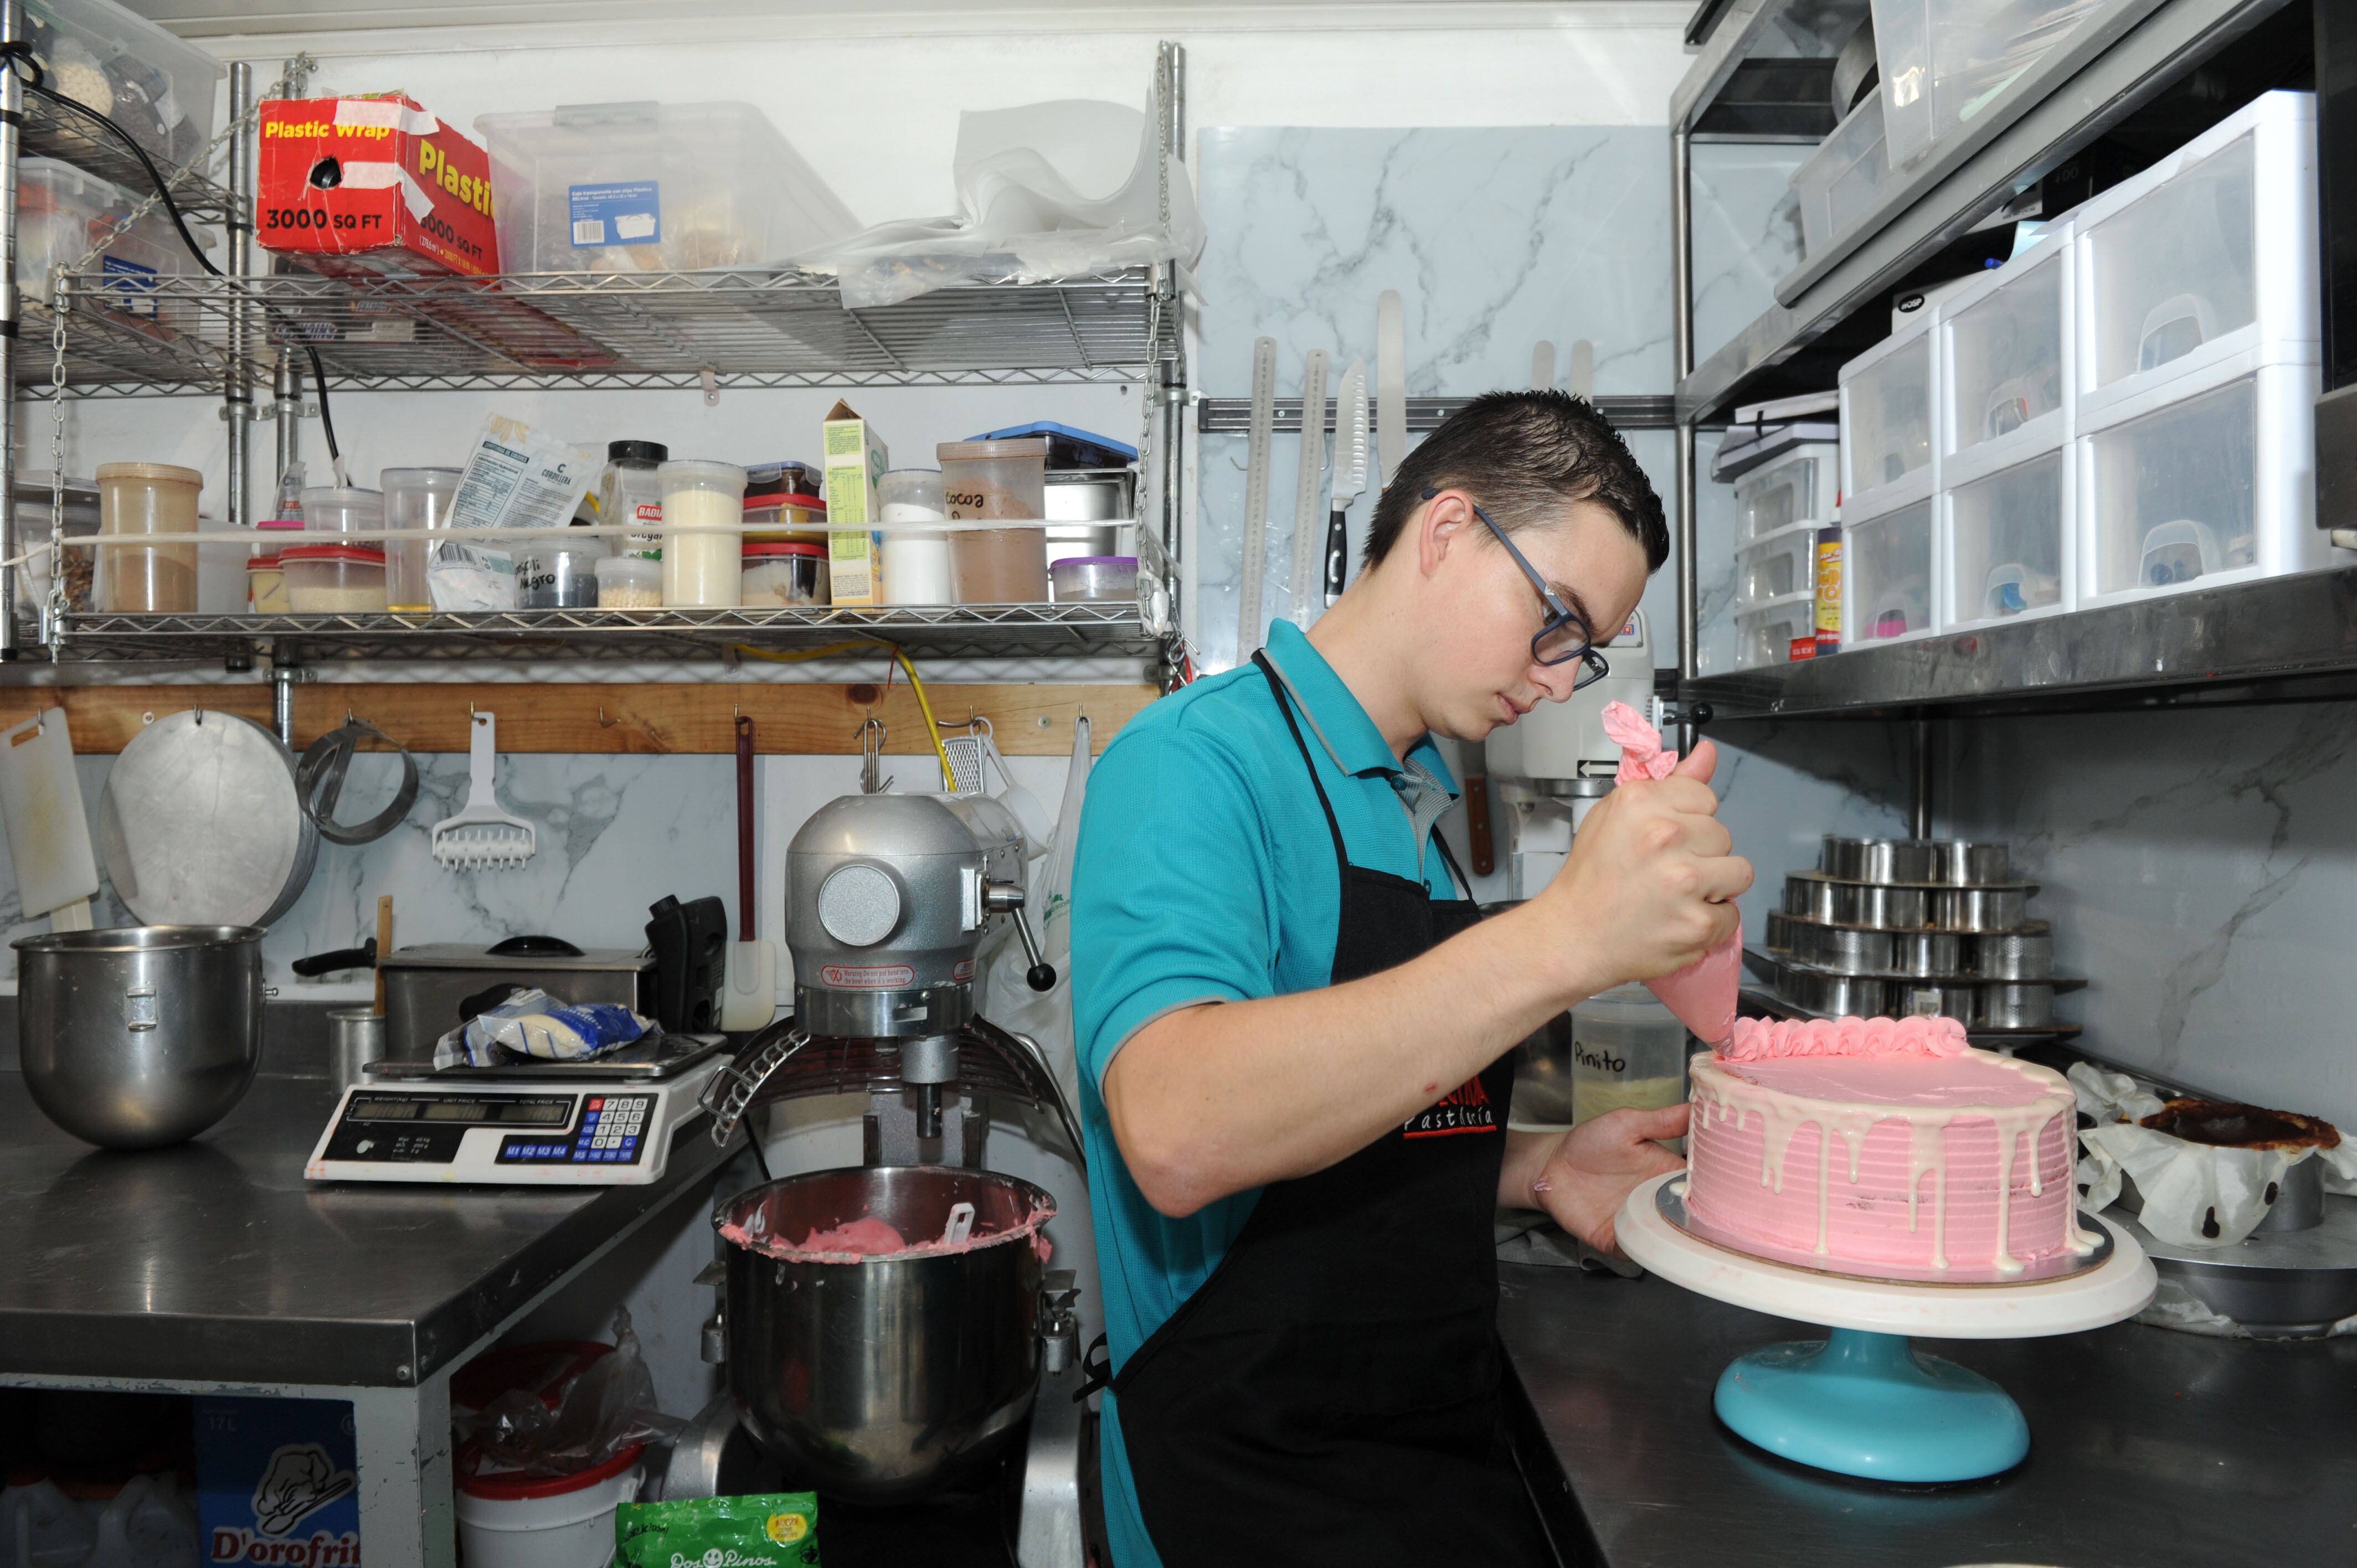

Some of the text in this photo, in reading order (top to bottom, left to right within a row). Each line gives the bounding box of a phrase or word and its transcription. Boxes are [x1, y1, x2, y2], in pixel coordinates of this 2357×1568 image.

[265, 120, 390, 140] Plastic Wrap
[419, 138, 495, 220] Plasti
[266, 209, 382, 229] 3000 SQ FT
[457, 235, 470, 254] SQ
[472, 244, 482, 261] FT
[541, 468, 572, 485] CORDILLERA
[519, 574, 555, 590] Negro
[1575, 1041, 1625, 1072] Pinito
[613, 1126, 622, 1134] 2
[628, 1126, 637, 1134] 3
[594, 1138, 604, 1147] 0
[625, 1138, 632, 1147] C
[506, 1147, 519, 1155] M1
[522, 1147, 535, 1155] M2
[537, 1147, 550, 1155] M3
[552, 1147, 565, 1155] M4
[210, 1417, 236, 1432] 17 L
[670, 1549, 778, 1568] Dos Pinos
